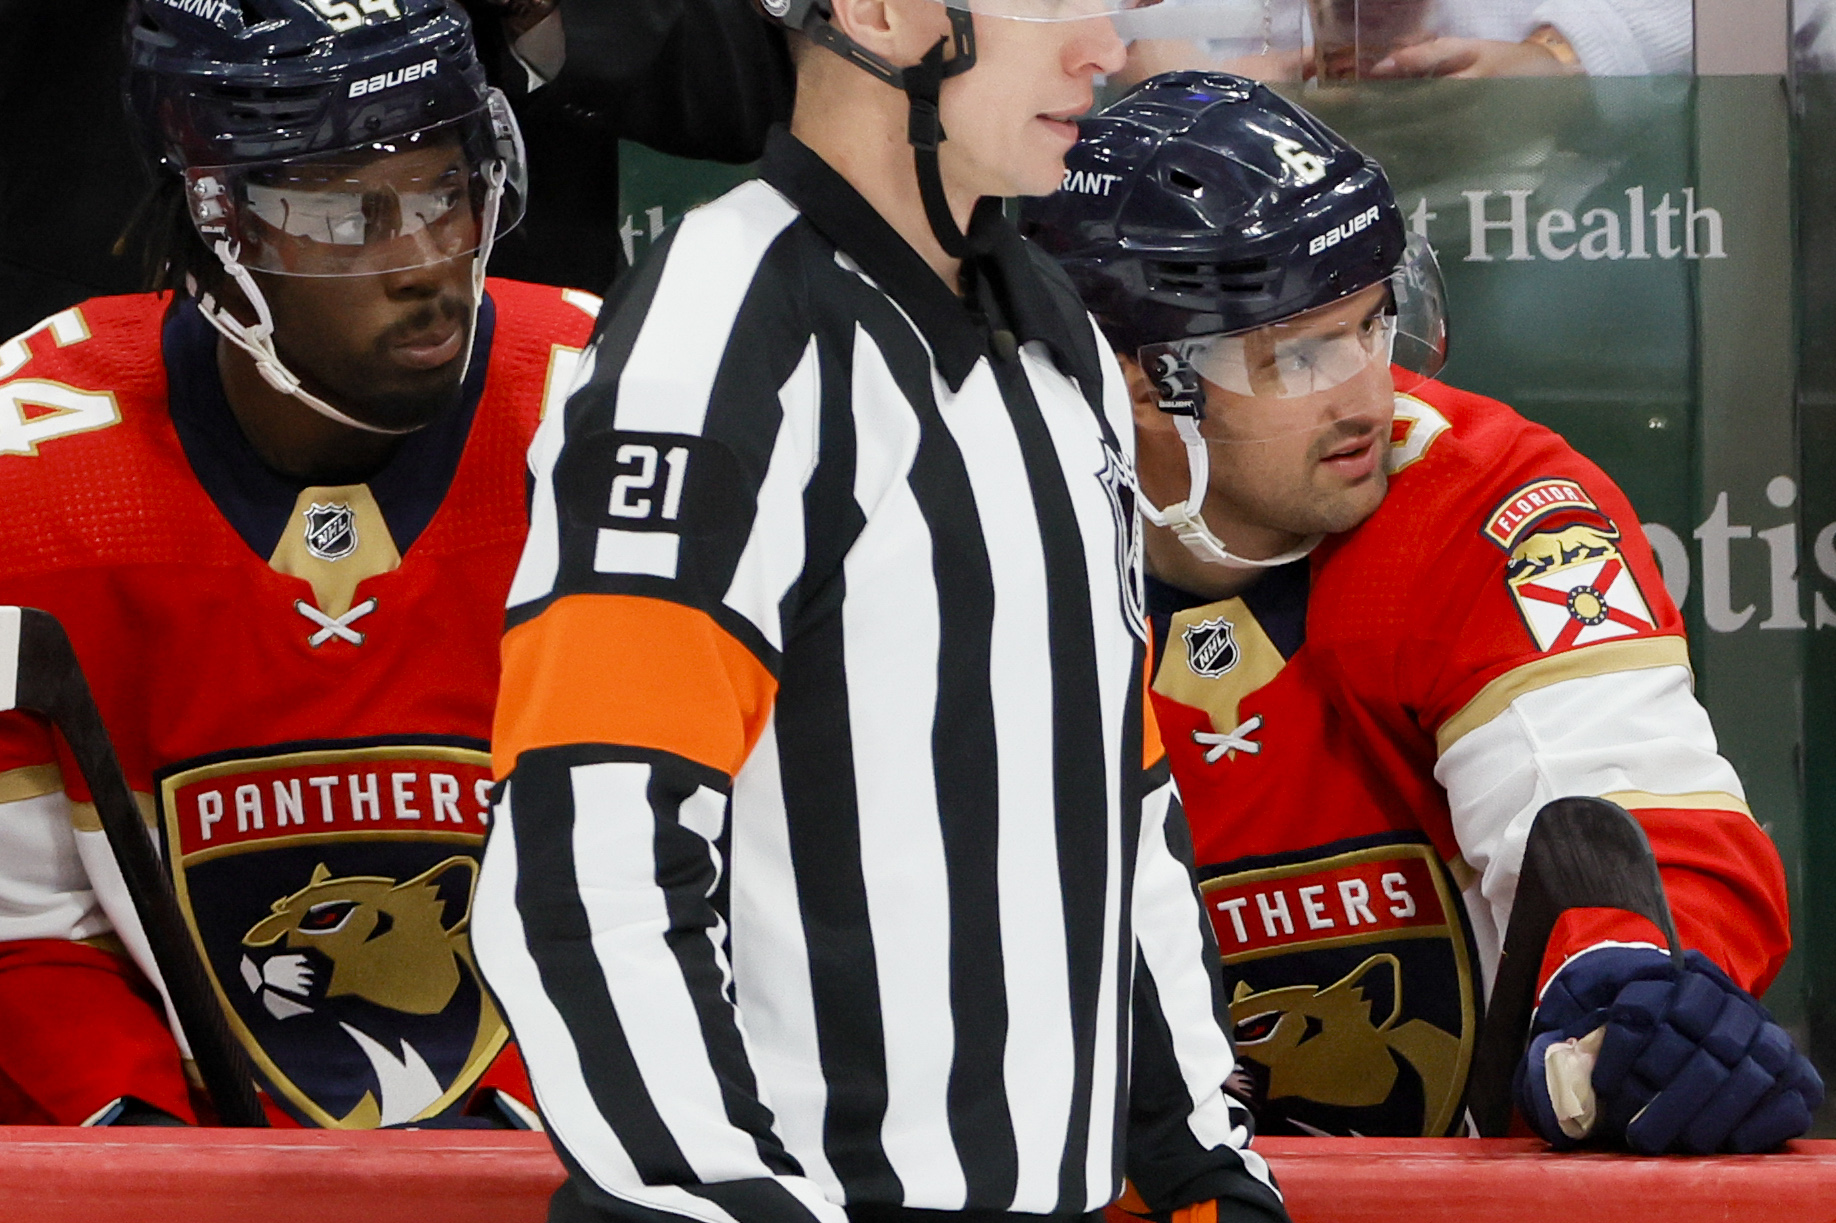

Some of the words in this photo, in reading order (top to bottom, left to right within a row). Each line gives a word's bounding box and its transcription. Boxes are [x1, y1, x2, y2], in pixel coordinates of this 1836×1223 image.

[348, 58, 438, 98] BAUER
[1308, 204, 1381, 257] BAUER
[1461, 185, 1728, 262] Health
[608, 444, 690, 521] 21
[1497, 486, 1580, 533] FLORIDA
[1216, 871, 1417, 945] THERS
